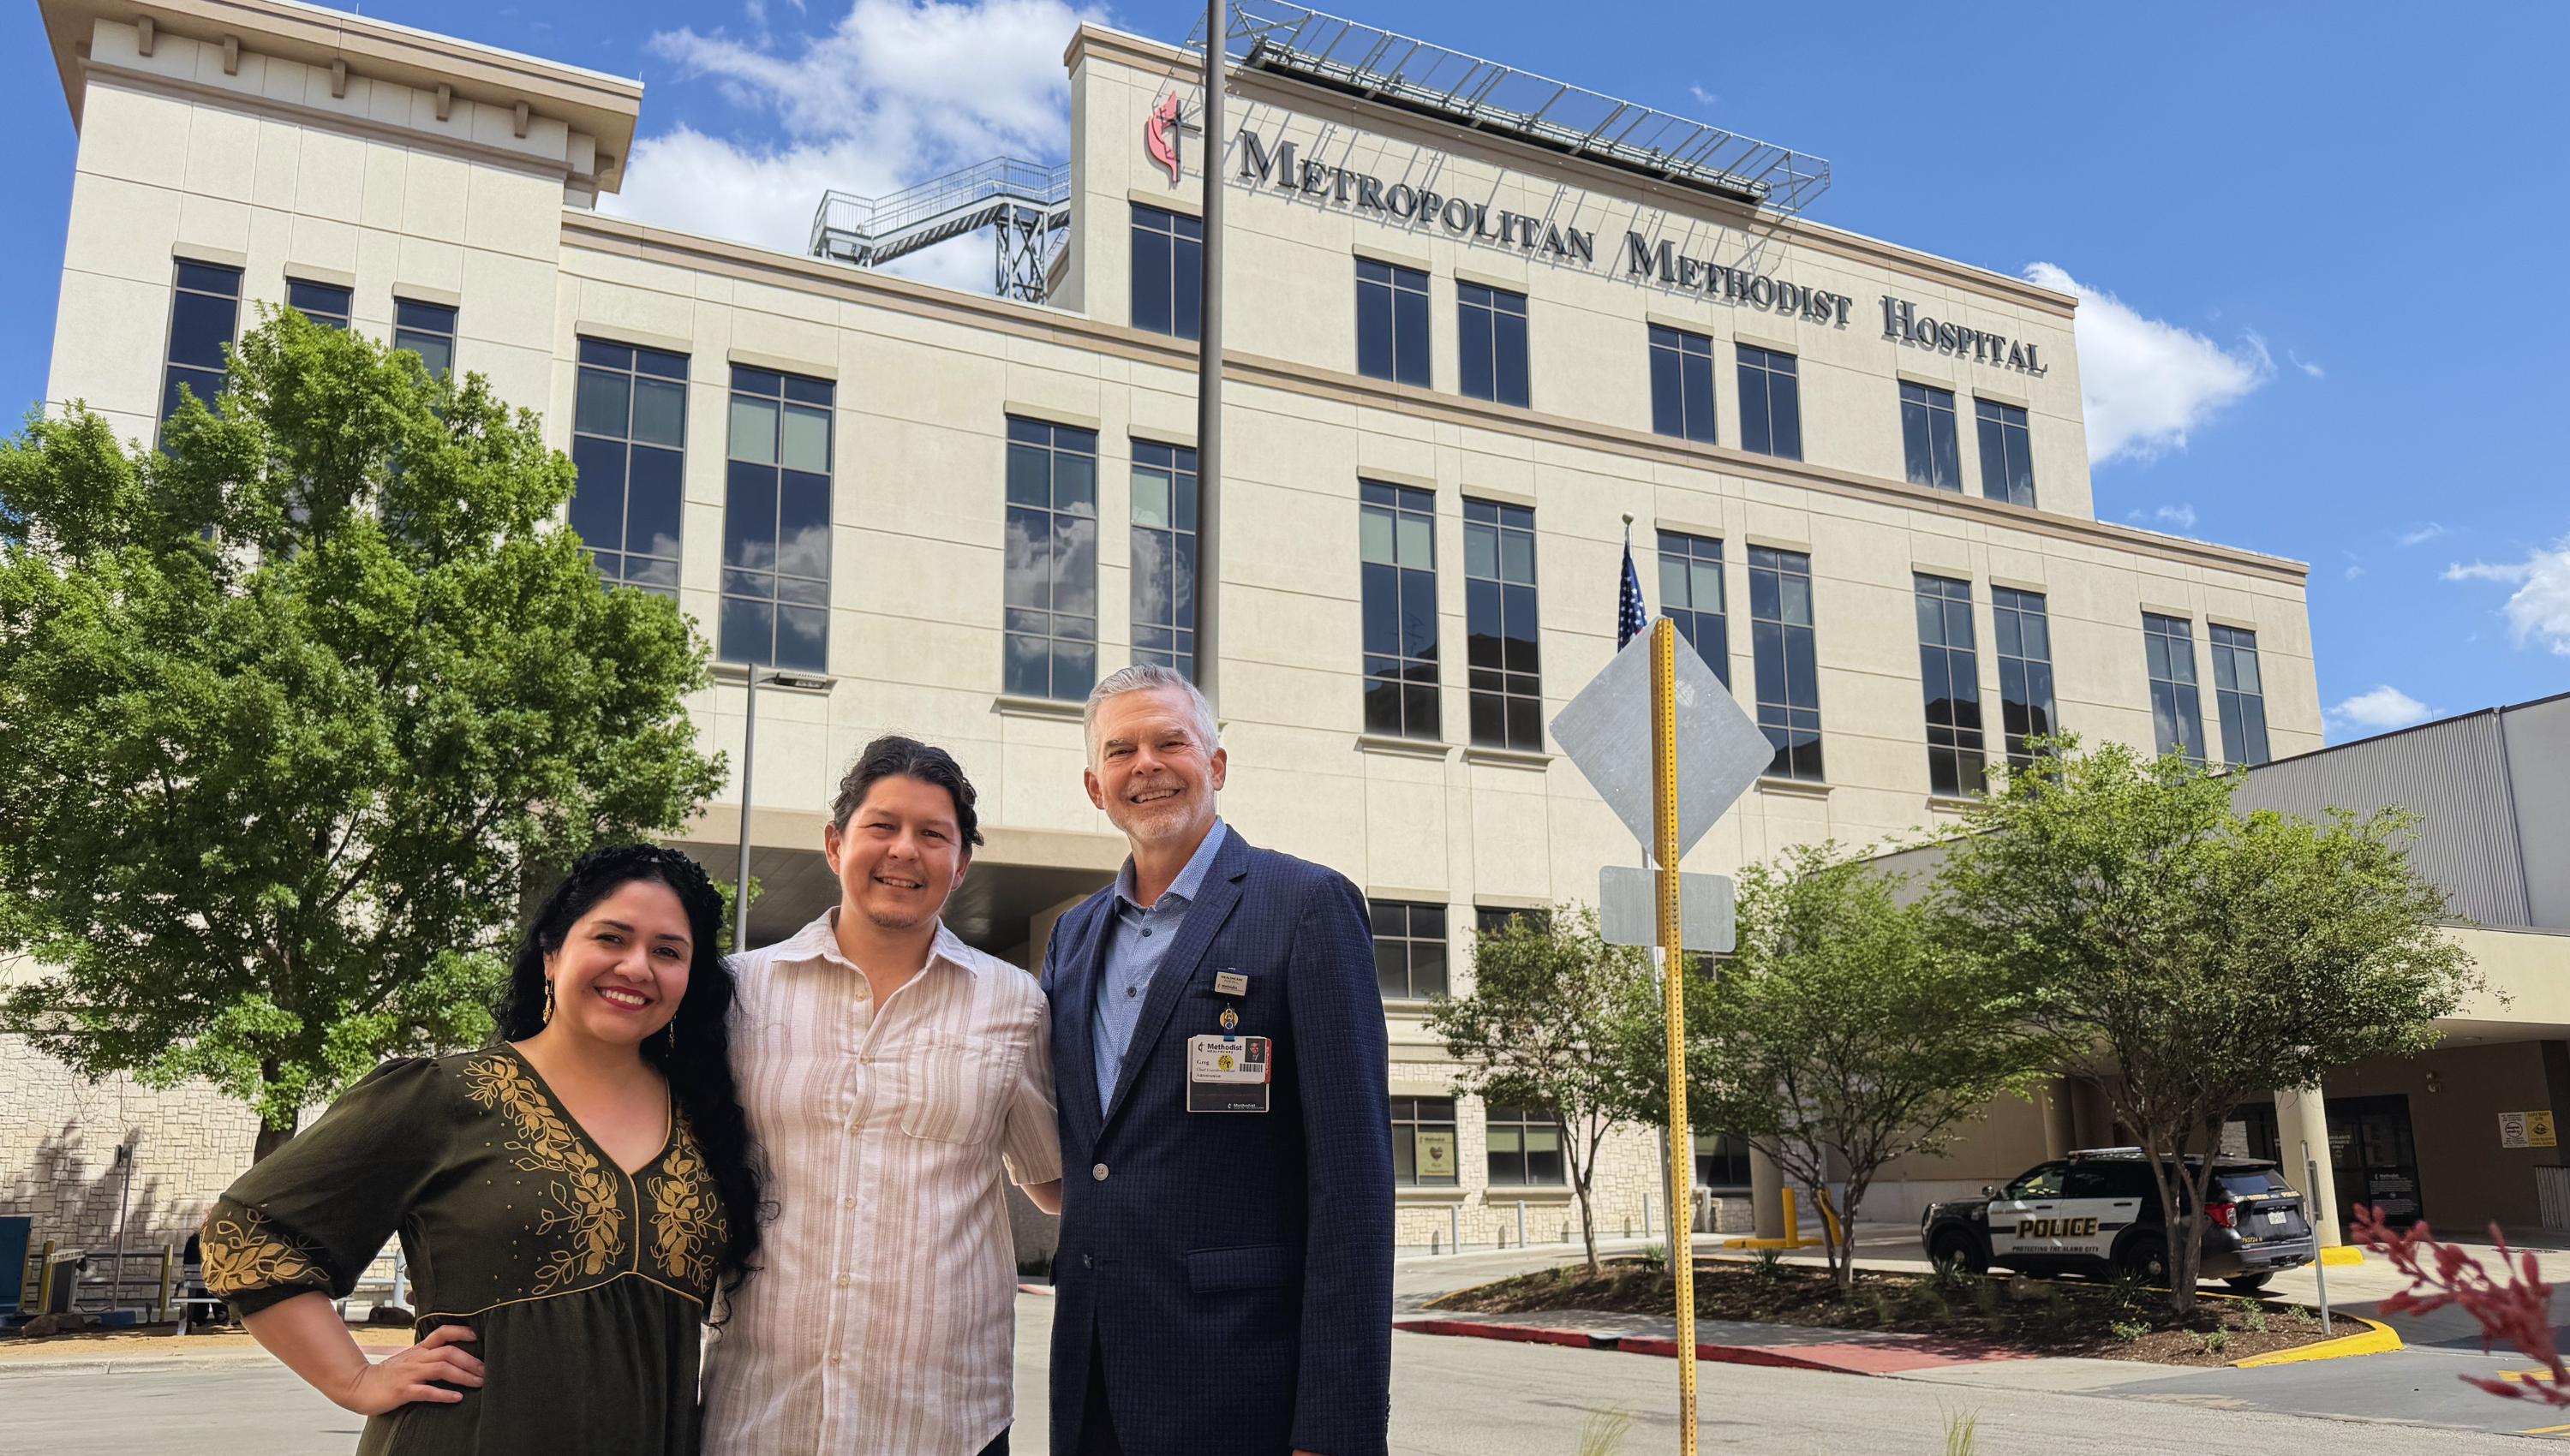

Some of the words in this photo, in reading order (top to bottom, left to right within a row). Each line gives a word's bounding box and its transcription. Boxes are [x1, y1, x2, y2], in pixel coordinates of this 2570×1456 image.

[1239, 128, 1594, 263] METROPOLITAN
[1627, 230, 1853, 326] METHODIST
[1881, 294, 2048, 374] HOSPITAL
[2017, 1217, 2098, 1239] POLICE
